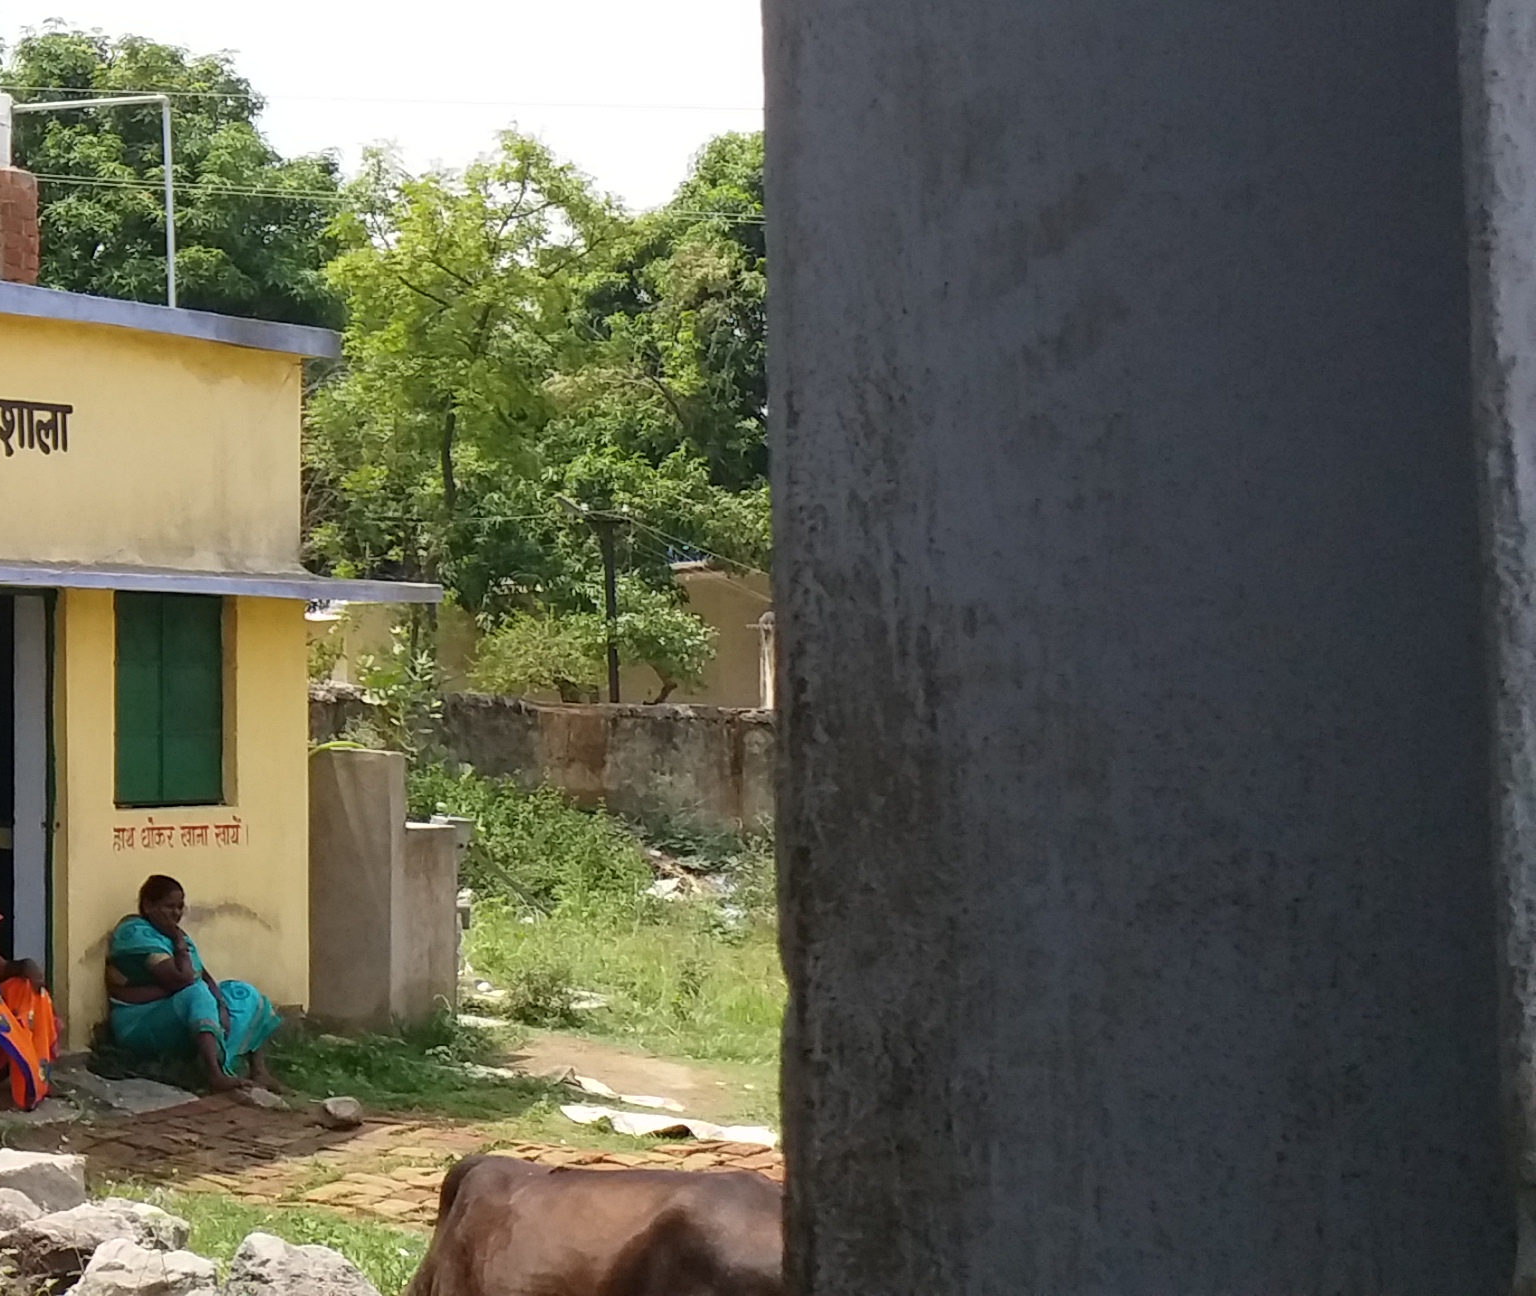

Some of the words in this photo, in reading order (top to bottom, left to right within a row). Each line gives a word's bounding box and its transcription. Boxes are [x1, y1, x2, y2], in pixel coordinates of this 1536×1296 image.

[113, 827, 135, 853] हाथ
[141, 816, 175, 849] धोकर
[180, 825, 209, 847] खाना
